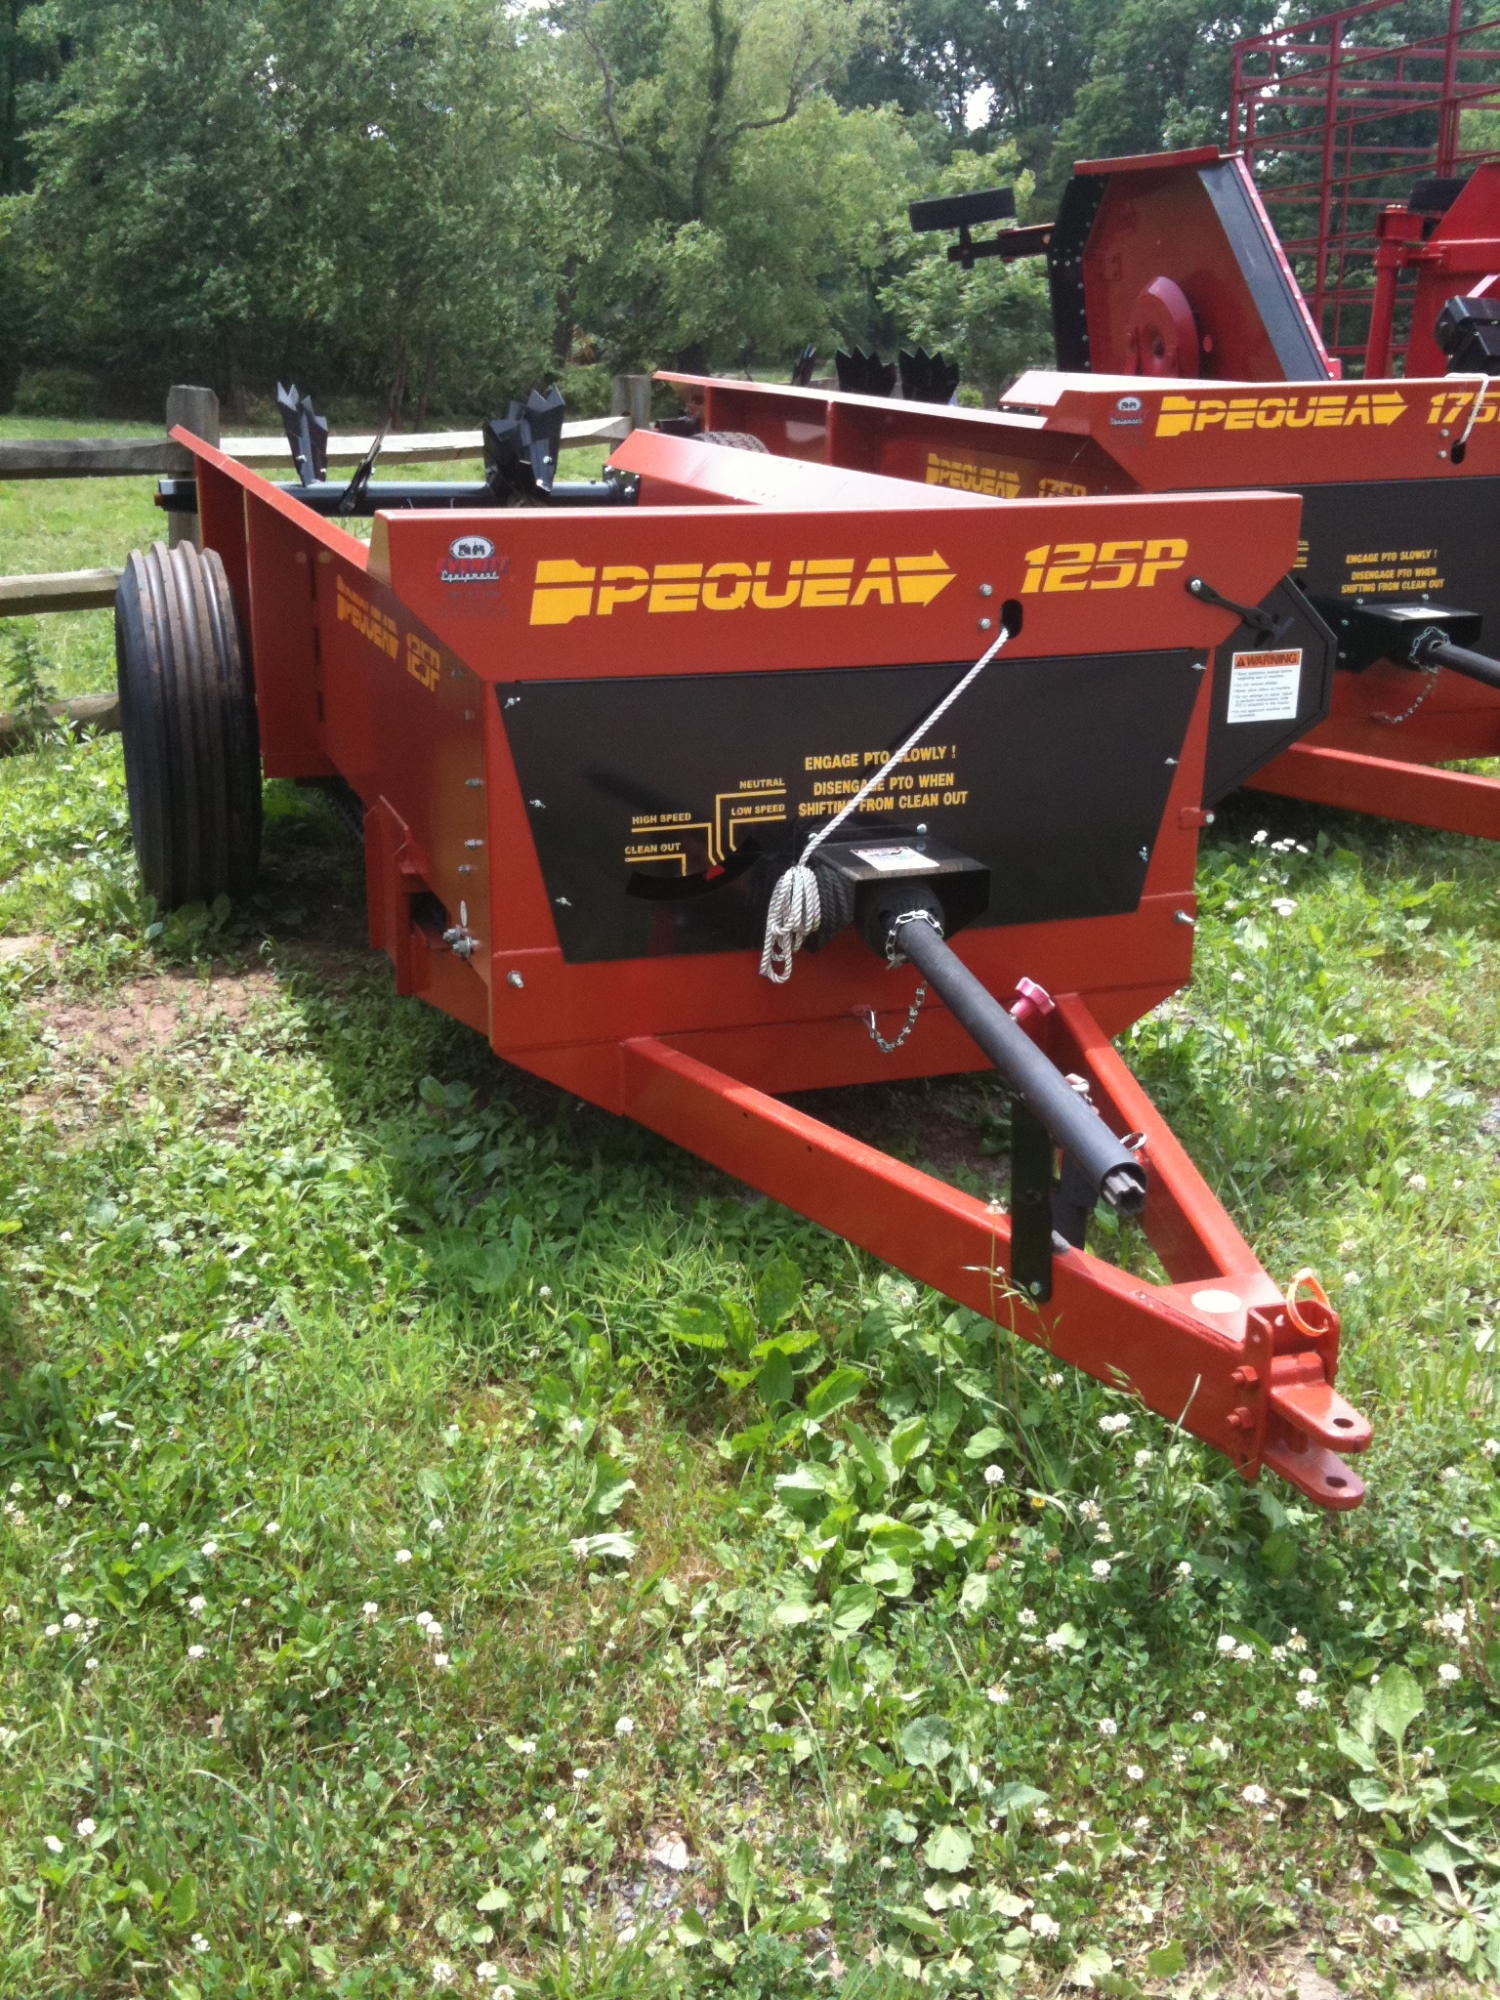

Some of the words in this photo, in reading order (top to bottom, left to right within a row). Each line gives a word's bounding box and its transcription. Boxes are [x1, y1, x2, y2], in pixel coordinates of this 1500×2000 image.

[1194, 395, 1370, 431] PEQUEA
[1427, 391, 1500, 424] 175
[597, 558, 894, 615] PEQUEA
[1020, 538, 1188, 594] 125P
[1247, 652, 1297, 665] WARNING
[805, 753, 859, 771] ENGAGE
[864, 751, 890, 766] PTO
[897, 746, 947, 763] LOWLY
[739, 778, 785, 789] NEUTRAL
[889, 776, 914, 790] PTO
[918, 773, 955, 788] WHEN
[859, 797, 894, 812] FROM
[898, 794, 939, 809] CLEAN
[943, 791, 969, 805] OUT
[731, 807, 752, 816] LOW
[754, 804, 785, 814] SPEED
[632, 814, 658, 825] HIGH
[659, 812, 692, 822] SPEED
[624, 844, 658, 855] CLEAN
[660, 842, 681, 852] OUT
